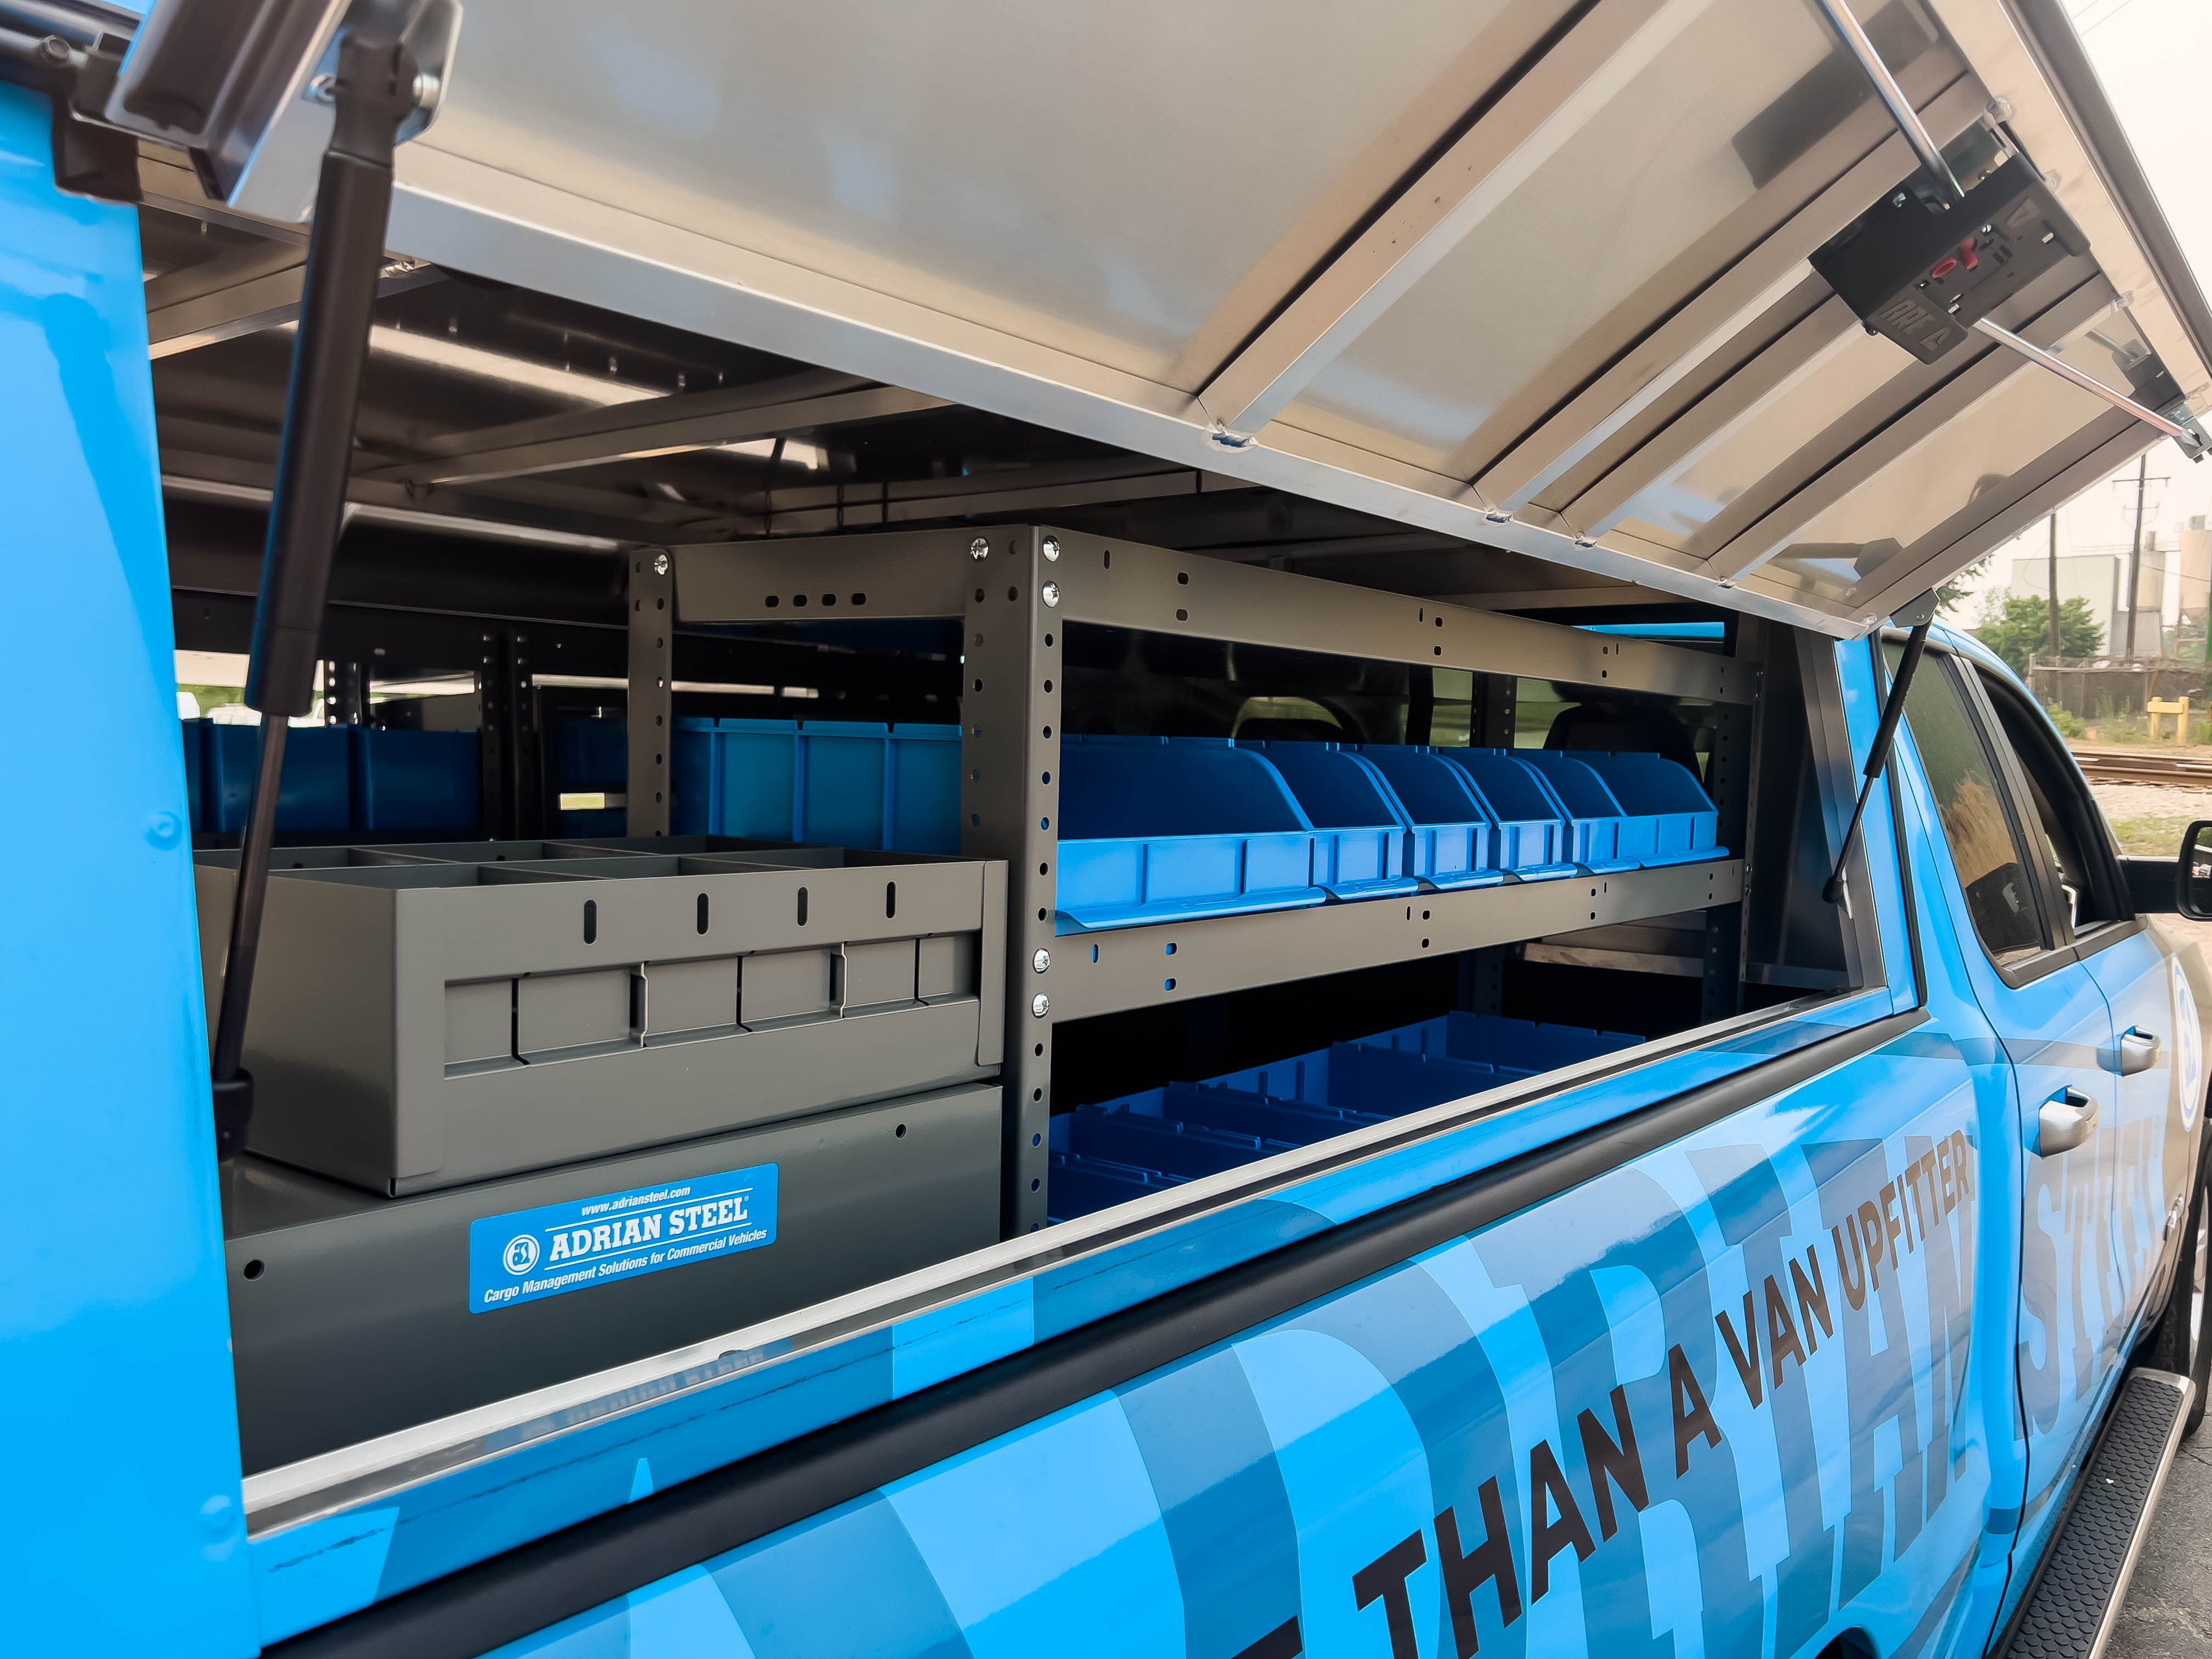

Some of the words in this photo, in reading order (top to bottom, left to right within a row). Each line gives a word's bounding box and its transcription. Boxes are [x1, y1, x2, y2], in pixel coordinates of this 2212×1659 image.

[582, 1187, 691, 1216] www.adriansteel.com
[484, 1286, 519, 1303] Cargo
[522, 1266, 596, 1294] Management
[598, 1257, 648, 1277] Solutions
[650, 1252, 665, 1265] for
[667, 1237, 726, 1261] Commercial
[729, 1229, 768, 1247] Vehicles
[549, 1214, 662, 1262] ADRIAN
[1352, 1384, 1650, 1659] THAN
[1668, 1344, 1722, 1479] A
[1714, 1244, 1833, 1410] VAN
[1831, 1129, 1970, 1311] UPFITTER
